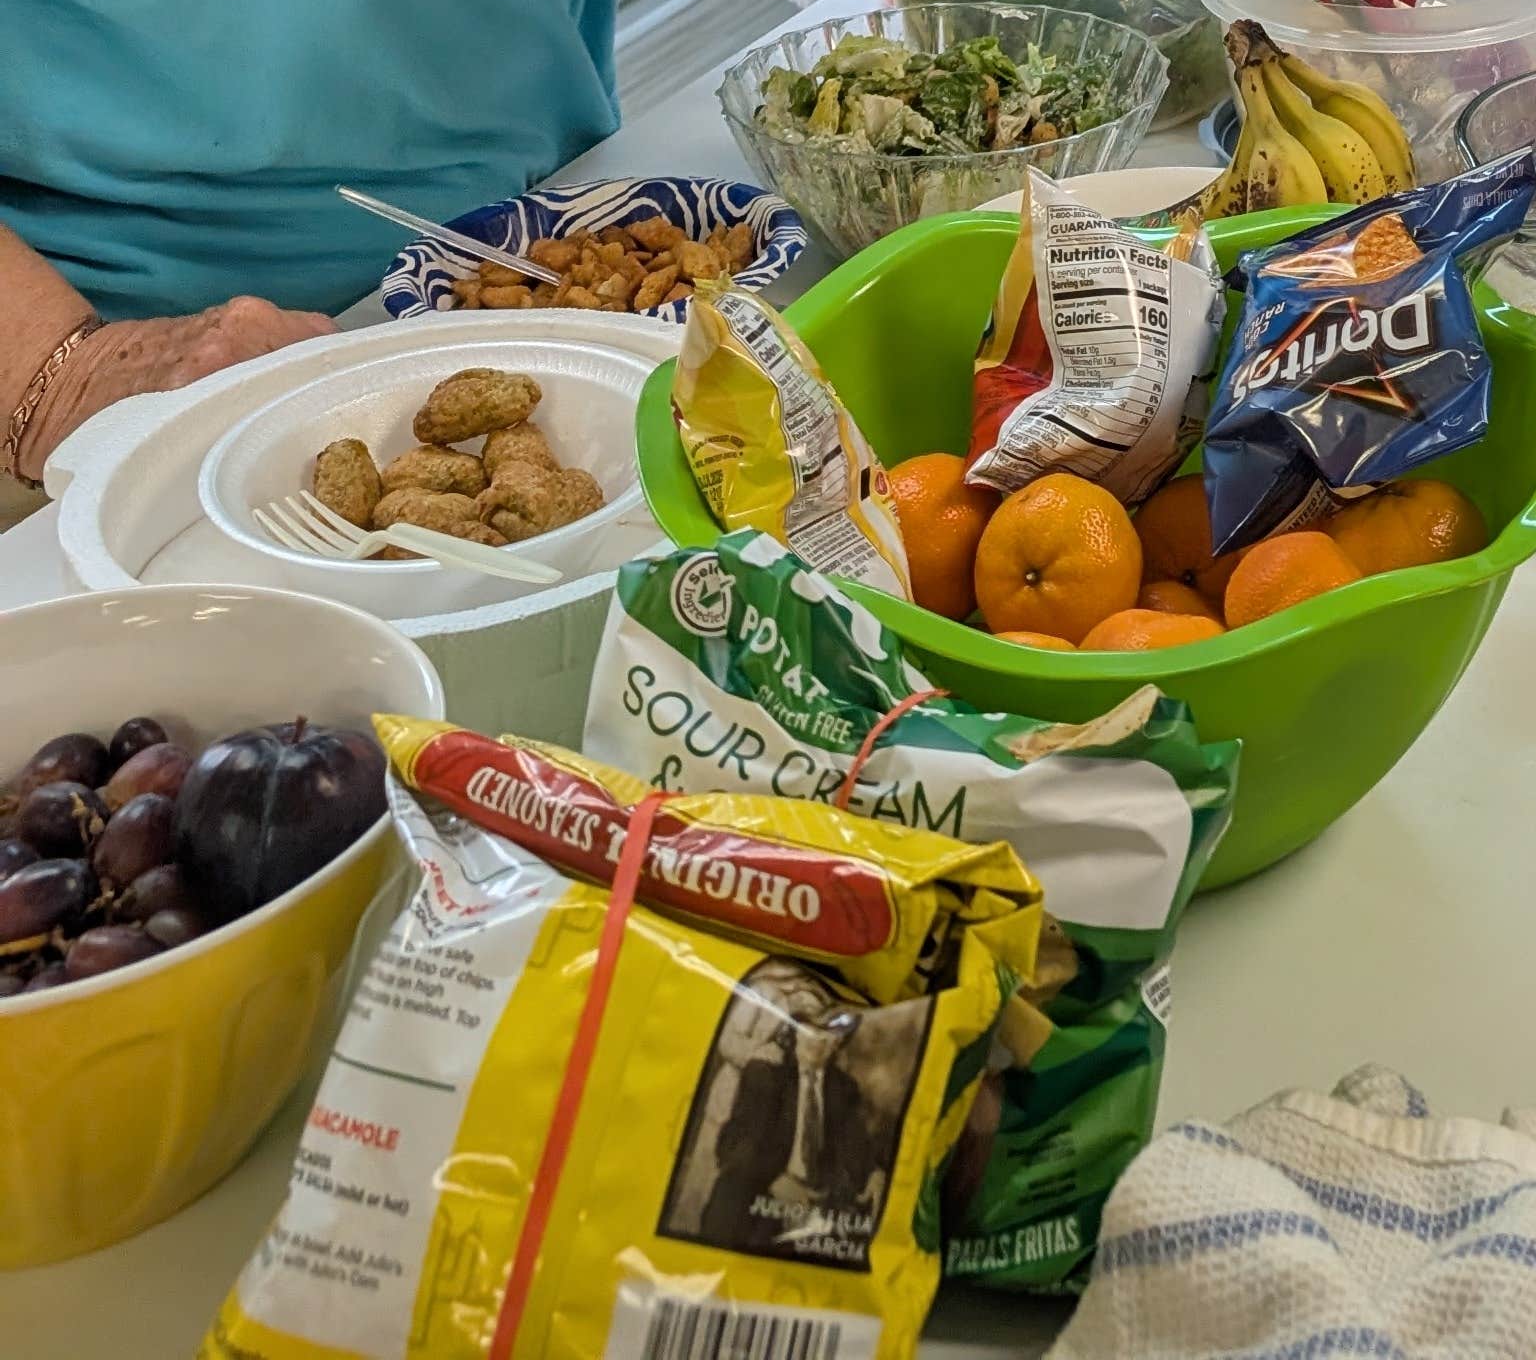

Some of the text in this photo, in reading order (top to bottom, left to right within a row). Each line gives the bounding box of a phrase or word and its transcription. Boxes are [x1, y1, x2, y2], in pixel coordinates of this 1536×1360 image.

[1050, 245, 1168, 269] Nutrition Facts
[1088, 267, 1101, 277] per
[1051, 279, 1078, 290] Serving
[1140, 305, 1168, 329] 160
[1226, 292, 1430, 414] Doritos
[738, 604, 830, 704] POTAT
[812, 711, 854, 746] FREE
[623, 664, 968, 839] SOUR CREAM
[464, 765, 822, 923] ORIGINL SEASONED
[1013, 1215, 1081, 1265] FRITAS
